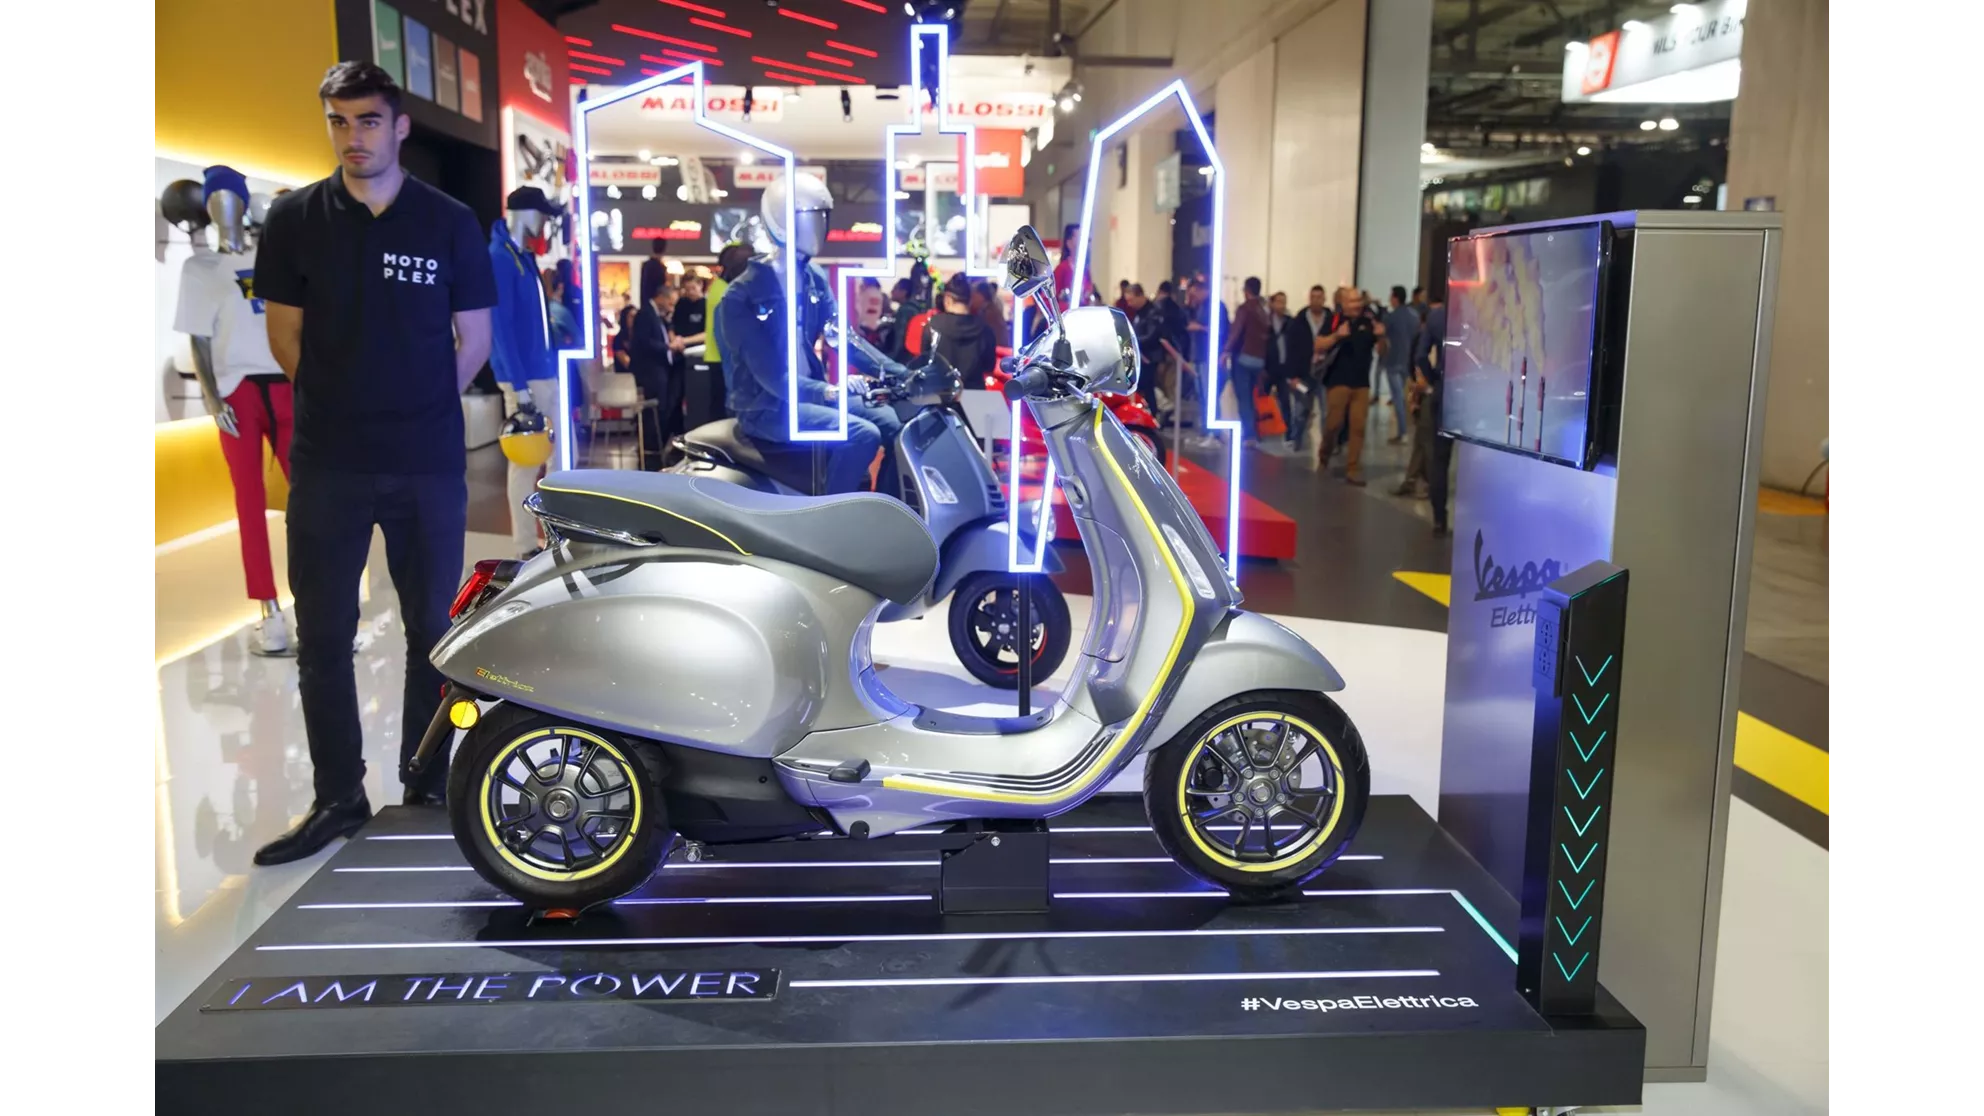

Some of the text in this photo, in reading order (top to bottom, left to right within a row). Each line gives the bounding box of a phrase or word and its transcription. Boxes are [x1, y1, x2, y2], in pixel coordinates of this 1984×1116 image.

[909, 102, 1044, 117] MLOSSI
[383, 252, 438, 271] MOTO
[383, 267, 436, 285] PLEX
[1473, 528, 1561, 602] Vespa
[1490, 603, 1538, 628] Elettr
[228, 972, 761, 1005] I AM THE POWER
[1240, 994, 1480, 1013] #VespaElettrica
